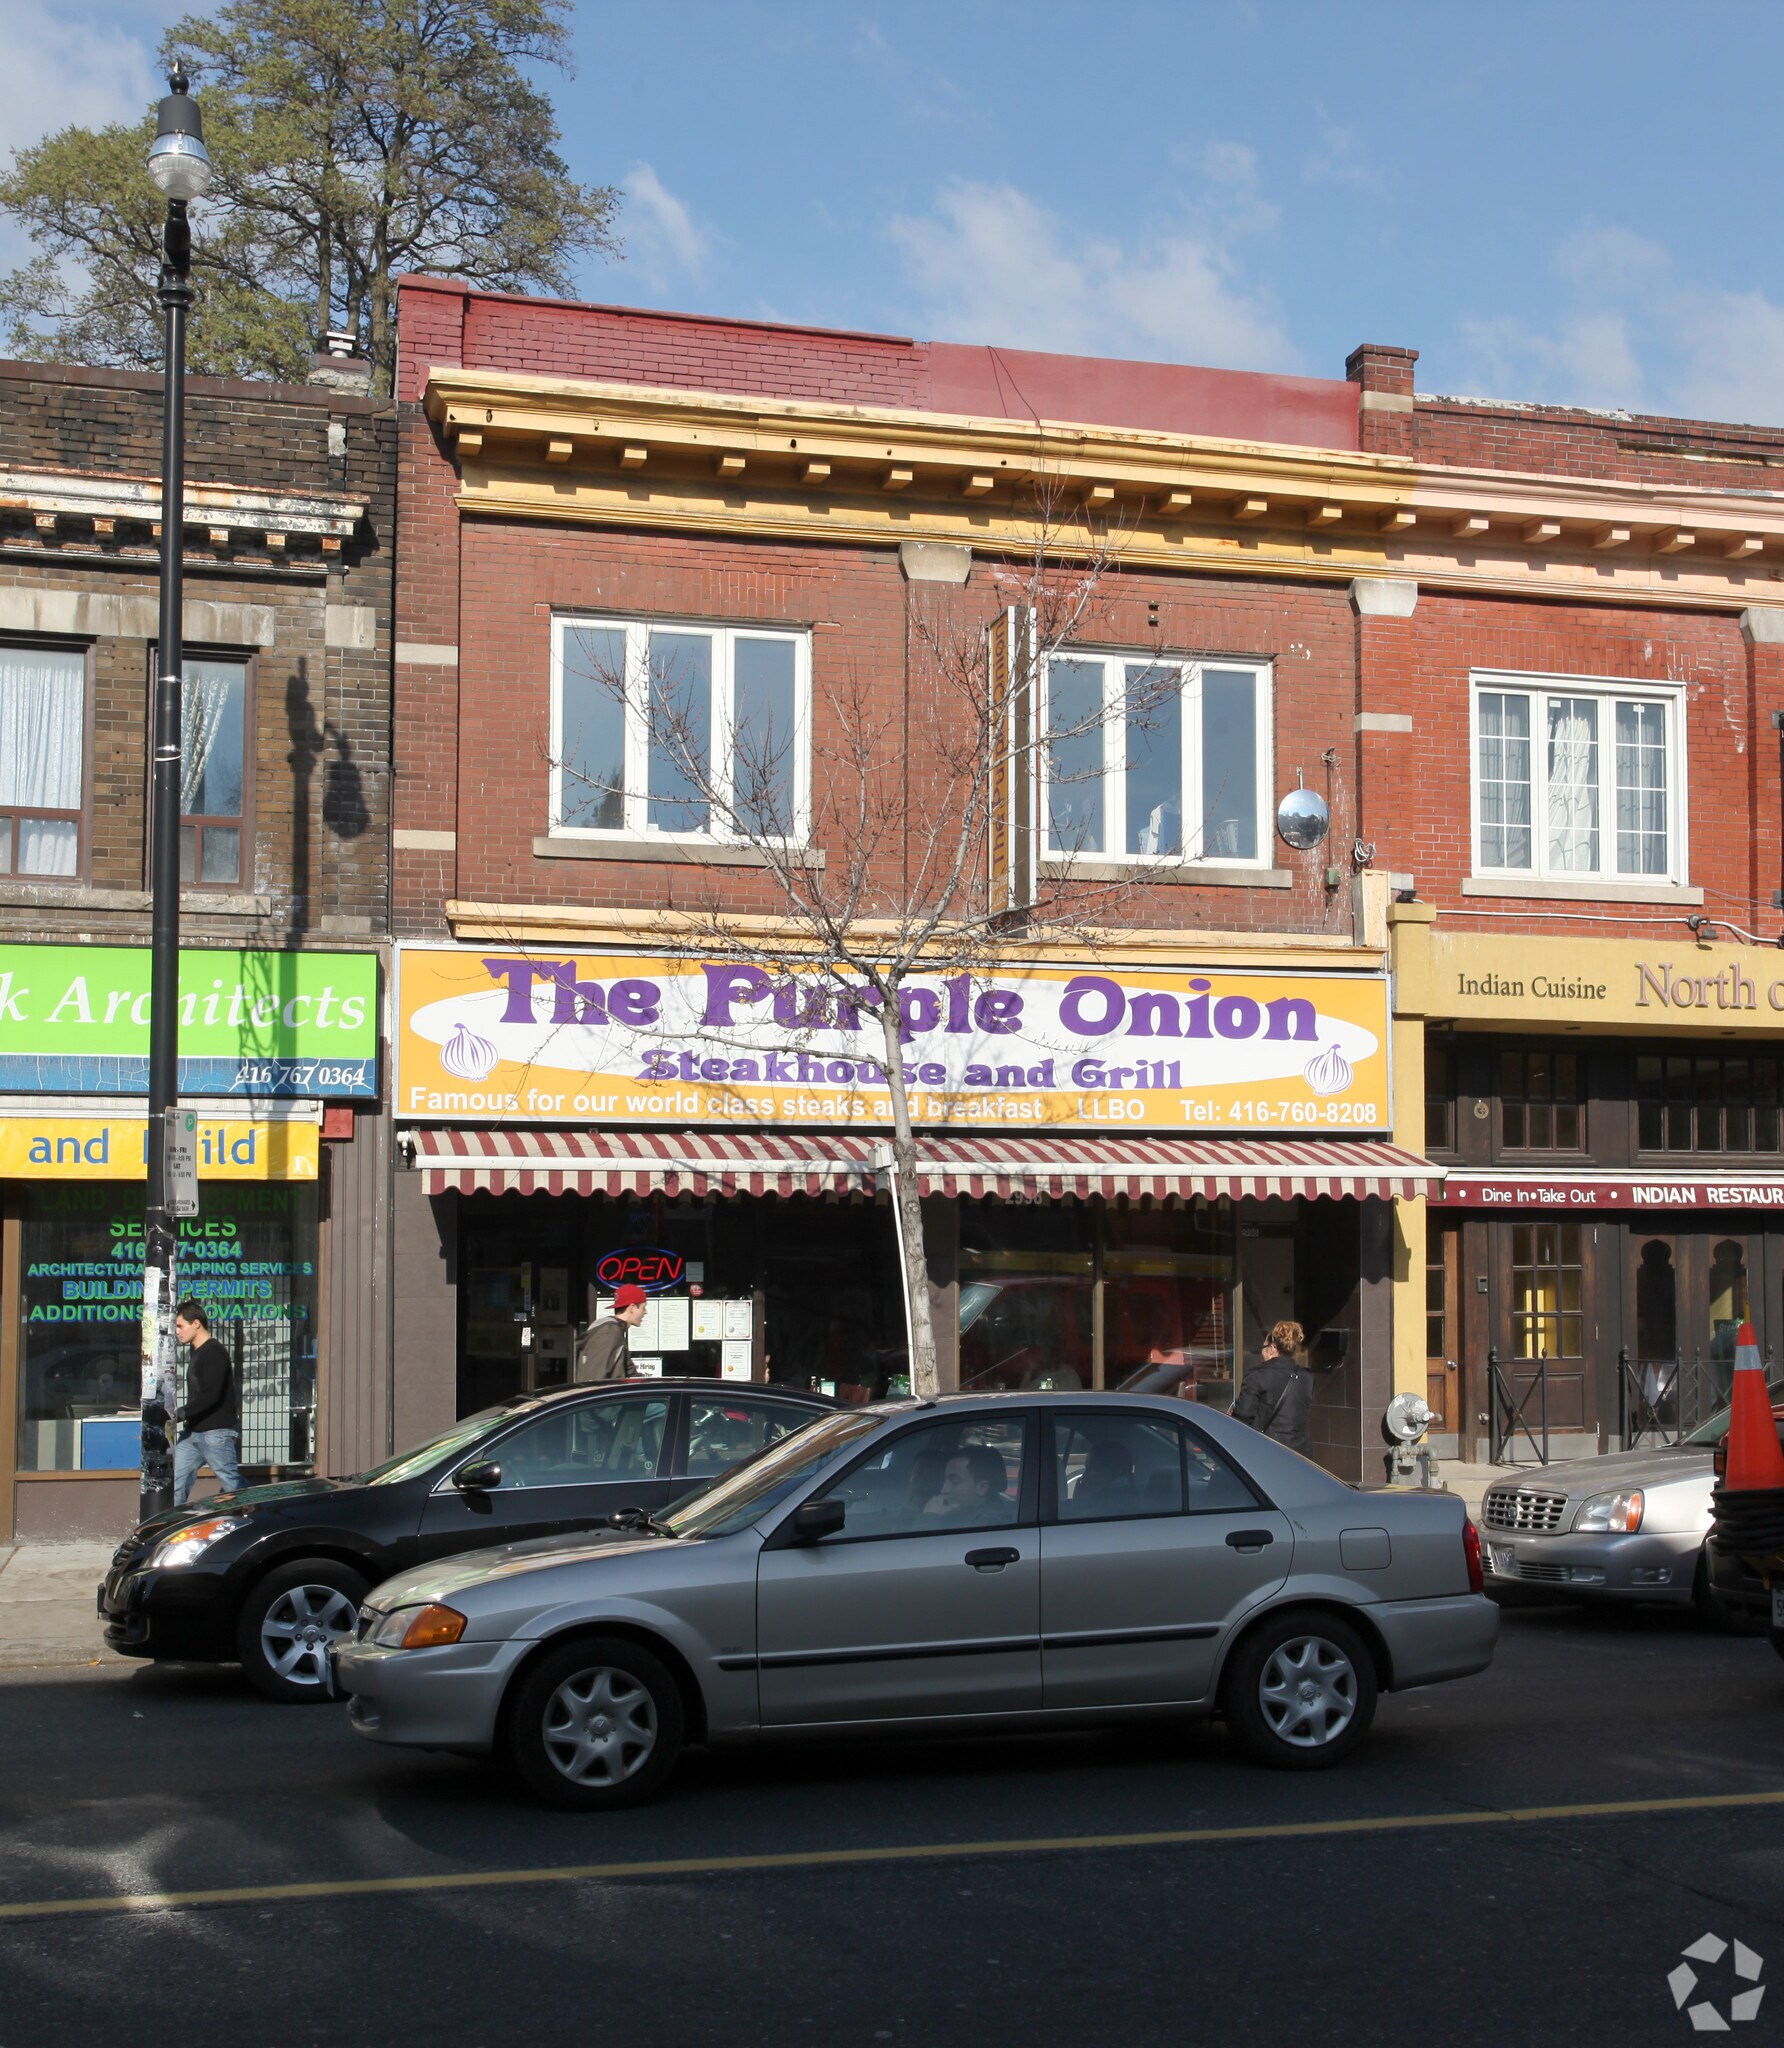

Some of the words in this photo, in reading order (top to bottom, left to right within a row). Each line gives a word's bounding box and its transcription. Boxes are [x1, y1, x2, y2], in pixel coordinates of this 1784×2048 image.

[1457, 973, 1524, 997] Indian
[1531, 976, 1607, 1001] Cuisine
[1635, 962, 1758, 1011] North
[481, 958, 662, 1027] The
[700, 961, 1024, 1044] Purple
[1059, 975, 1320, 1042] Onion
[237, 1064, 272, 1085] 416
[277, 1065, 314, 1086] 767
[319, 1066, 366, 1086] 0364
[635, 1049, 946, 1087] Steakhouse
[963, 1058, 1056, 1089] and
[1072, 1059, 1182, 1090] Grill
[411, 1087, 518, 1111] Famous
[527, 1088, 565, 1112] for
[574, 1095, 617, 1113] our
[626, 1091, 699, 1114] world
[707, 1092, 774, 1115] class
[783, 1094, 865, 1117] steaks
[928, 1096, 1042, 1119] breakfast
[1077, 1098, 1145, 1121] LLBO
[1181, 1099, 1221, 1122] Tel:
[1229, 1100, 1377, 1124] 416-760-8208
[29, 1129, 108, 1165] and
[143, 1129, 255, 1165] ild
[40, 1189, 106, 1212] LAND
[1482, 1187, 1512, 1203] Dine
[1570, 1188, 1597, 1203] Out
[1633, 1187, 1697, 1204] INDIAN
[110, 1214, 237, 1238] SEICES
[111, 1241, 243, 1260] 4167-0364
[27, 1263, 145, 1277] ARCHITECTURA
[240, 1262, 313, 1277] SERVICES
[599, 1257, 683, 1281] OPEN
[179, 1280, 273, 1300] PERMITS
